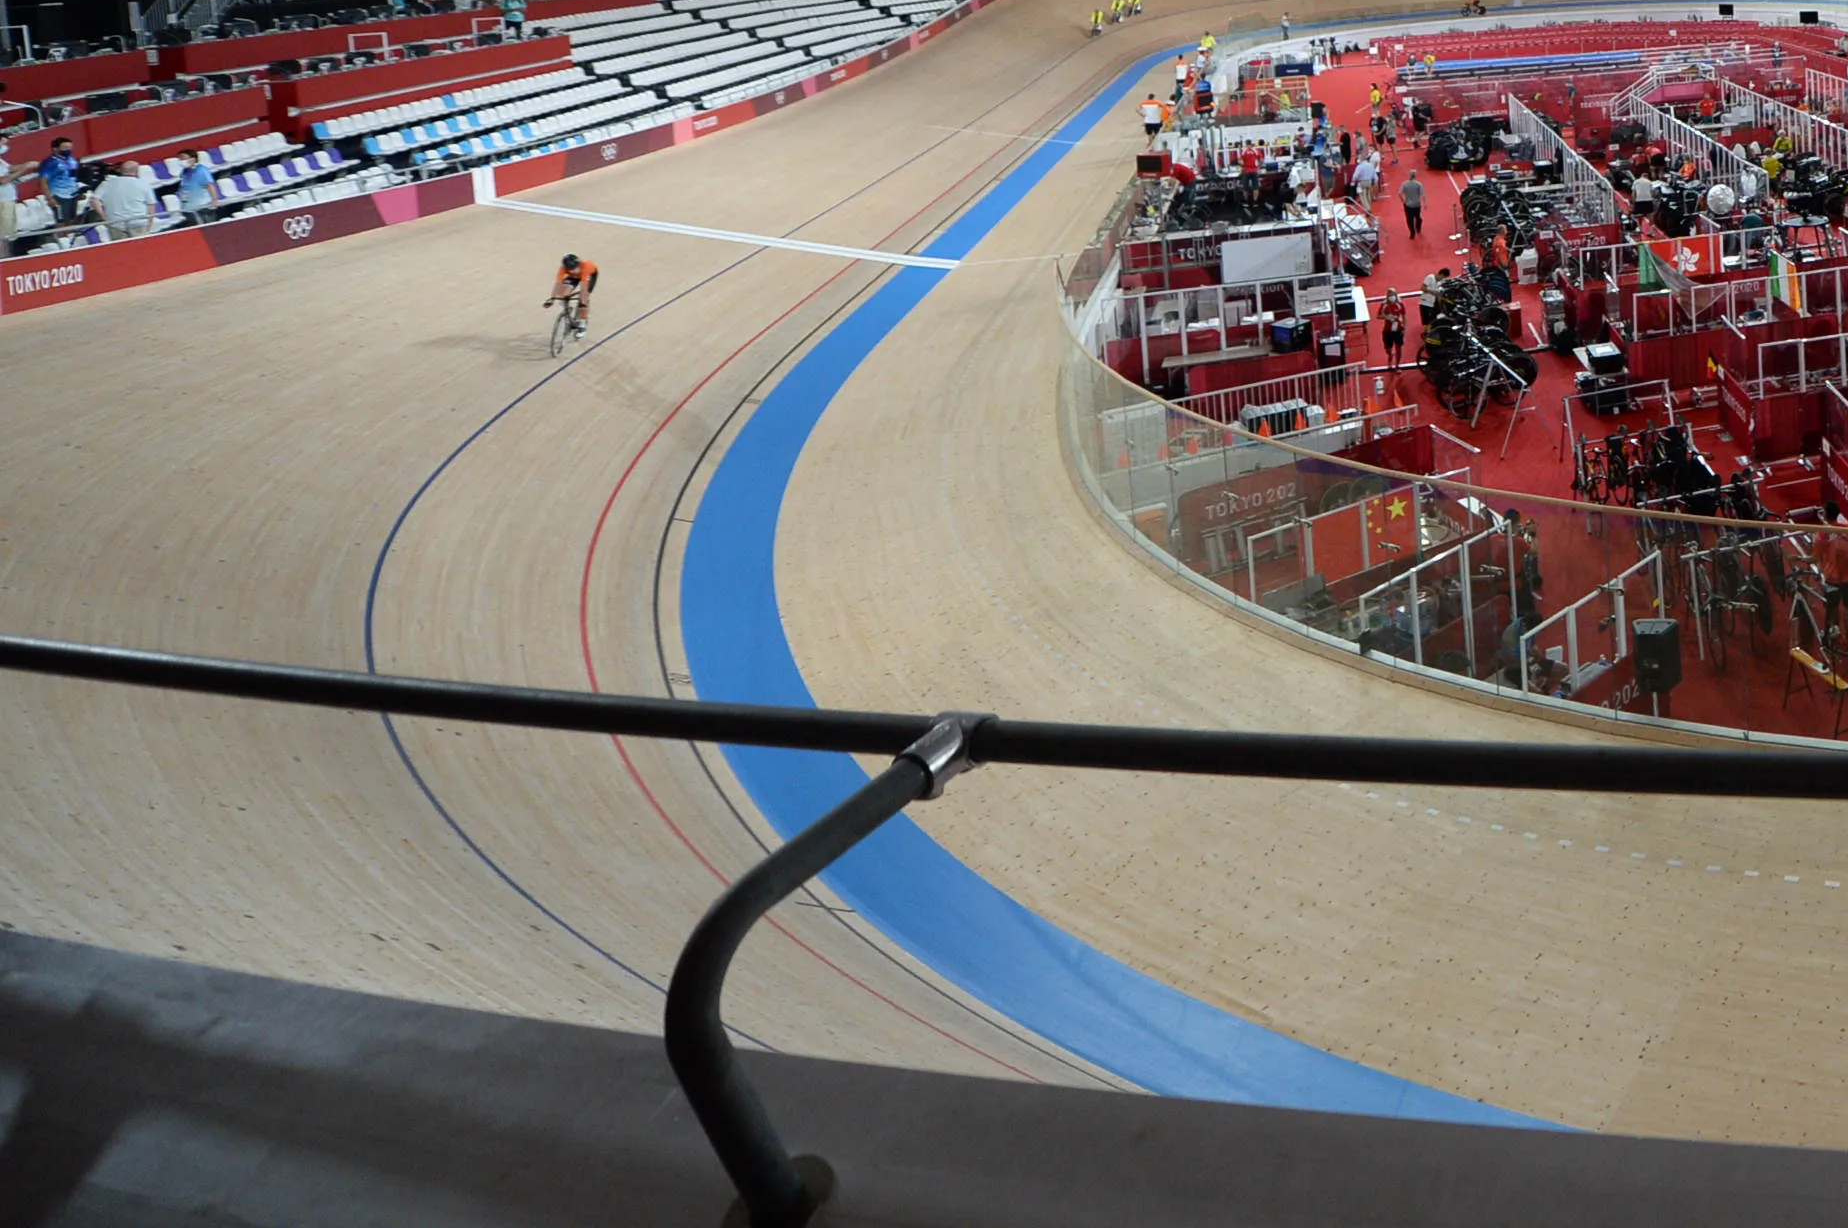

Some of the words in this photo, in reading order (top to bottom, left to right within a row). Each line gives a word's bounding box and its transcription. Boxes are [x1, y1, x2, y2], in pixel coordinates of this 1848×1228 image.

[6, 270, 50, 296] TOKYO
[51, 264, 84, 287] 2020
[1205, 492, 1262, 520] TOKYO
[1265, 482, 1297, 503] 202
